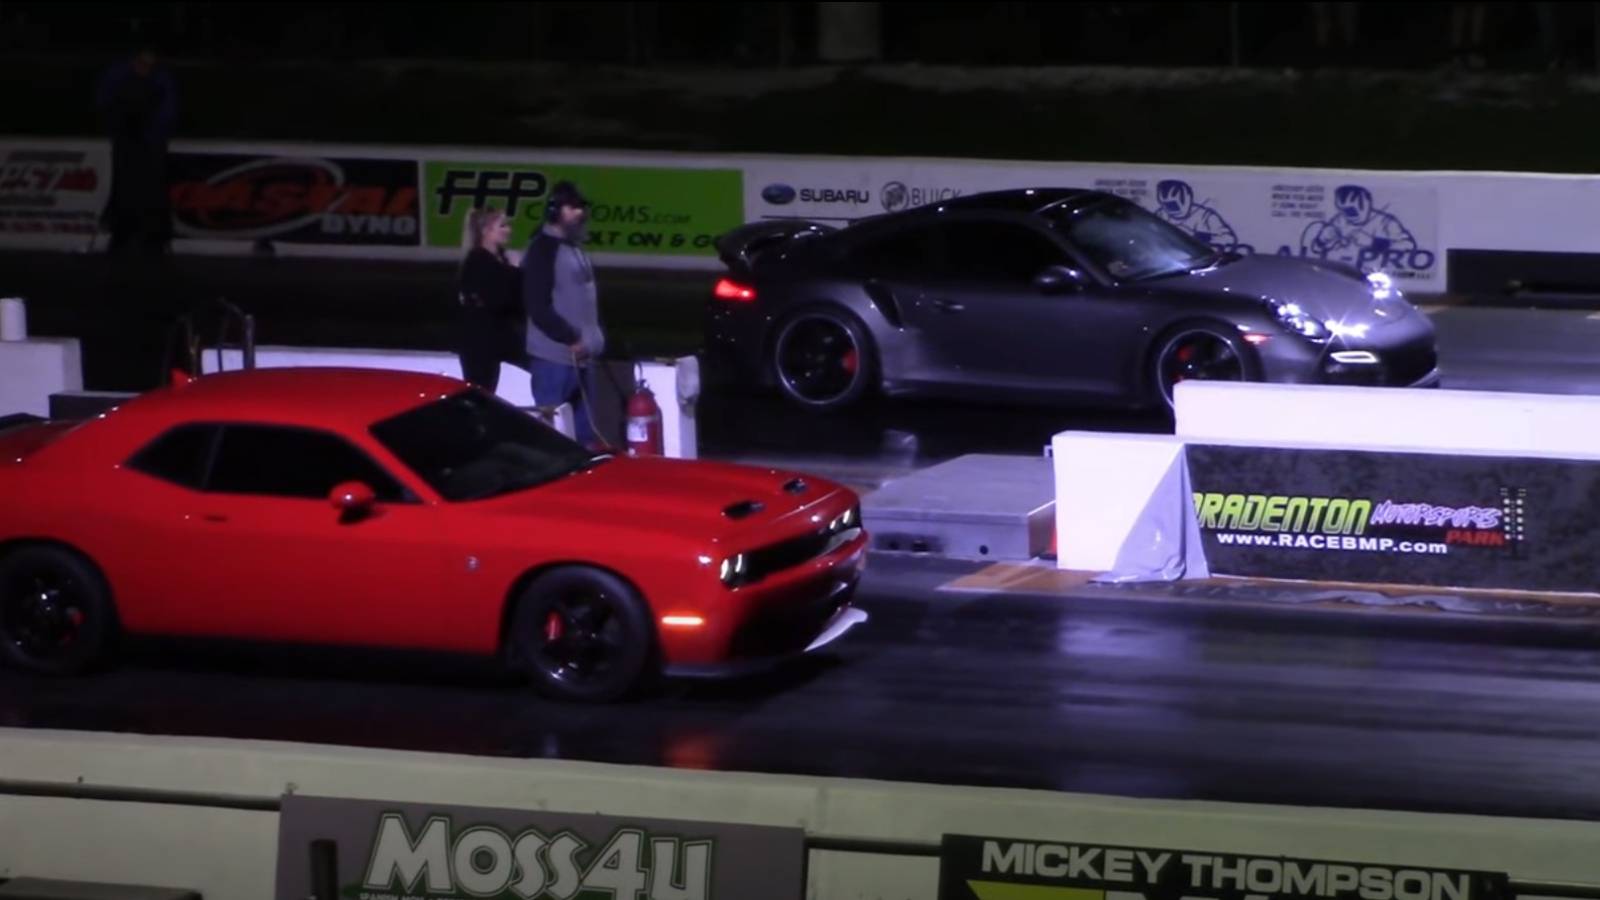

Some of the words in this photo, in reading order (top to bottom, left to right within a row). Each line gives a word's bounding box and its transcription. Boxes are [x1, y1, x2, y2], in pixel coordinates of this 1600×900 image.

[436, 170, 547, 217] FFP
[800, 188, 870, 204] SUBARU
[628, 231, 663, 247] ON
[670, 232, 685, 248] &
[1217, 532, 1448, 555] www.RACEBMP.com
[1446, 529, 1505, 546] PARK
[981, 840, 1171, 885] MICKEY
[1181, 854, 1471, 900] THOMPSON
